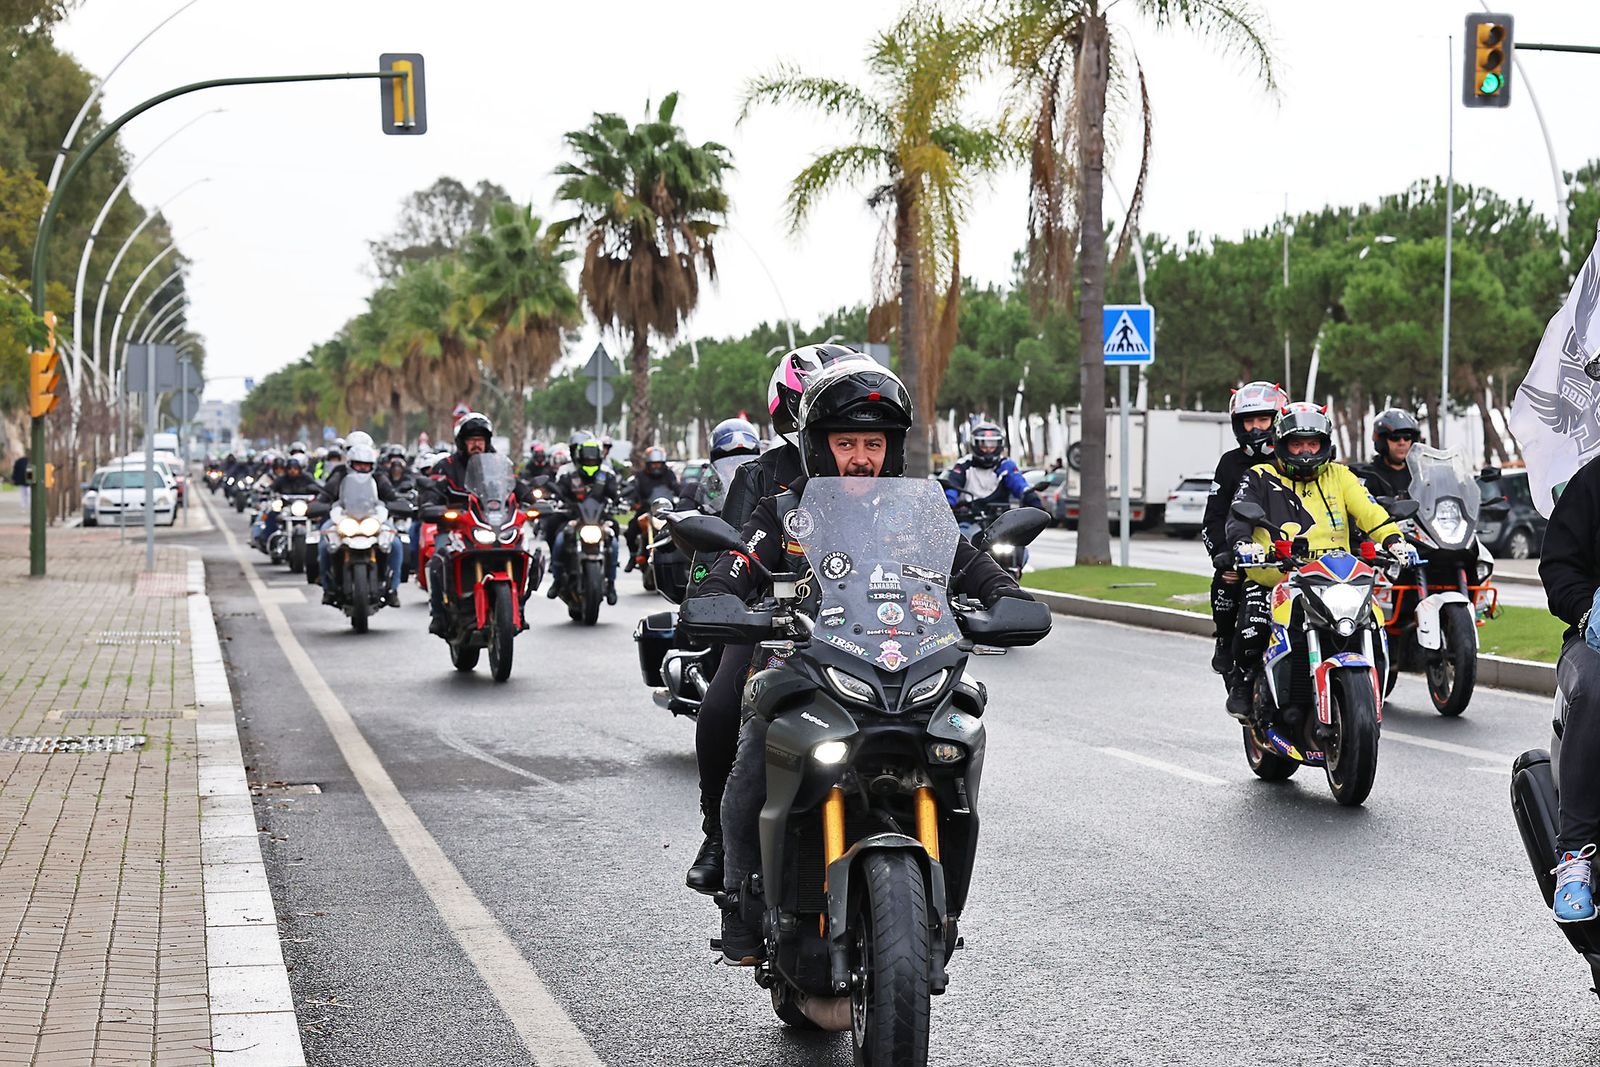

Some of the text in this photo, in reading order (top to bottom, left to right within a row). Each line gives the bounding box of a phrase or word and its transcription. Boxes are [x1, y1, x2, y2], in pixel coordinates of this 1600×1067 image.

[873, 592, 901, 600] IRON
[829, 635, 866, 656] IRON
[1272, 735, 1296, 755] HONDA
